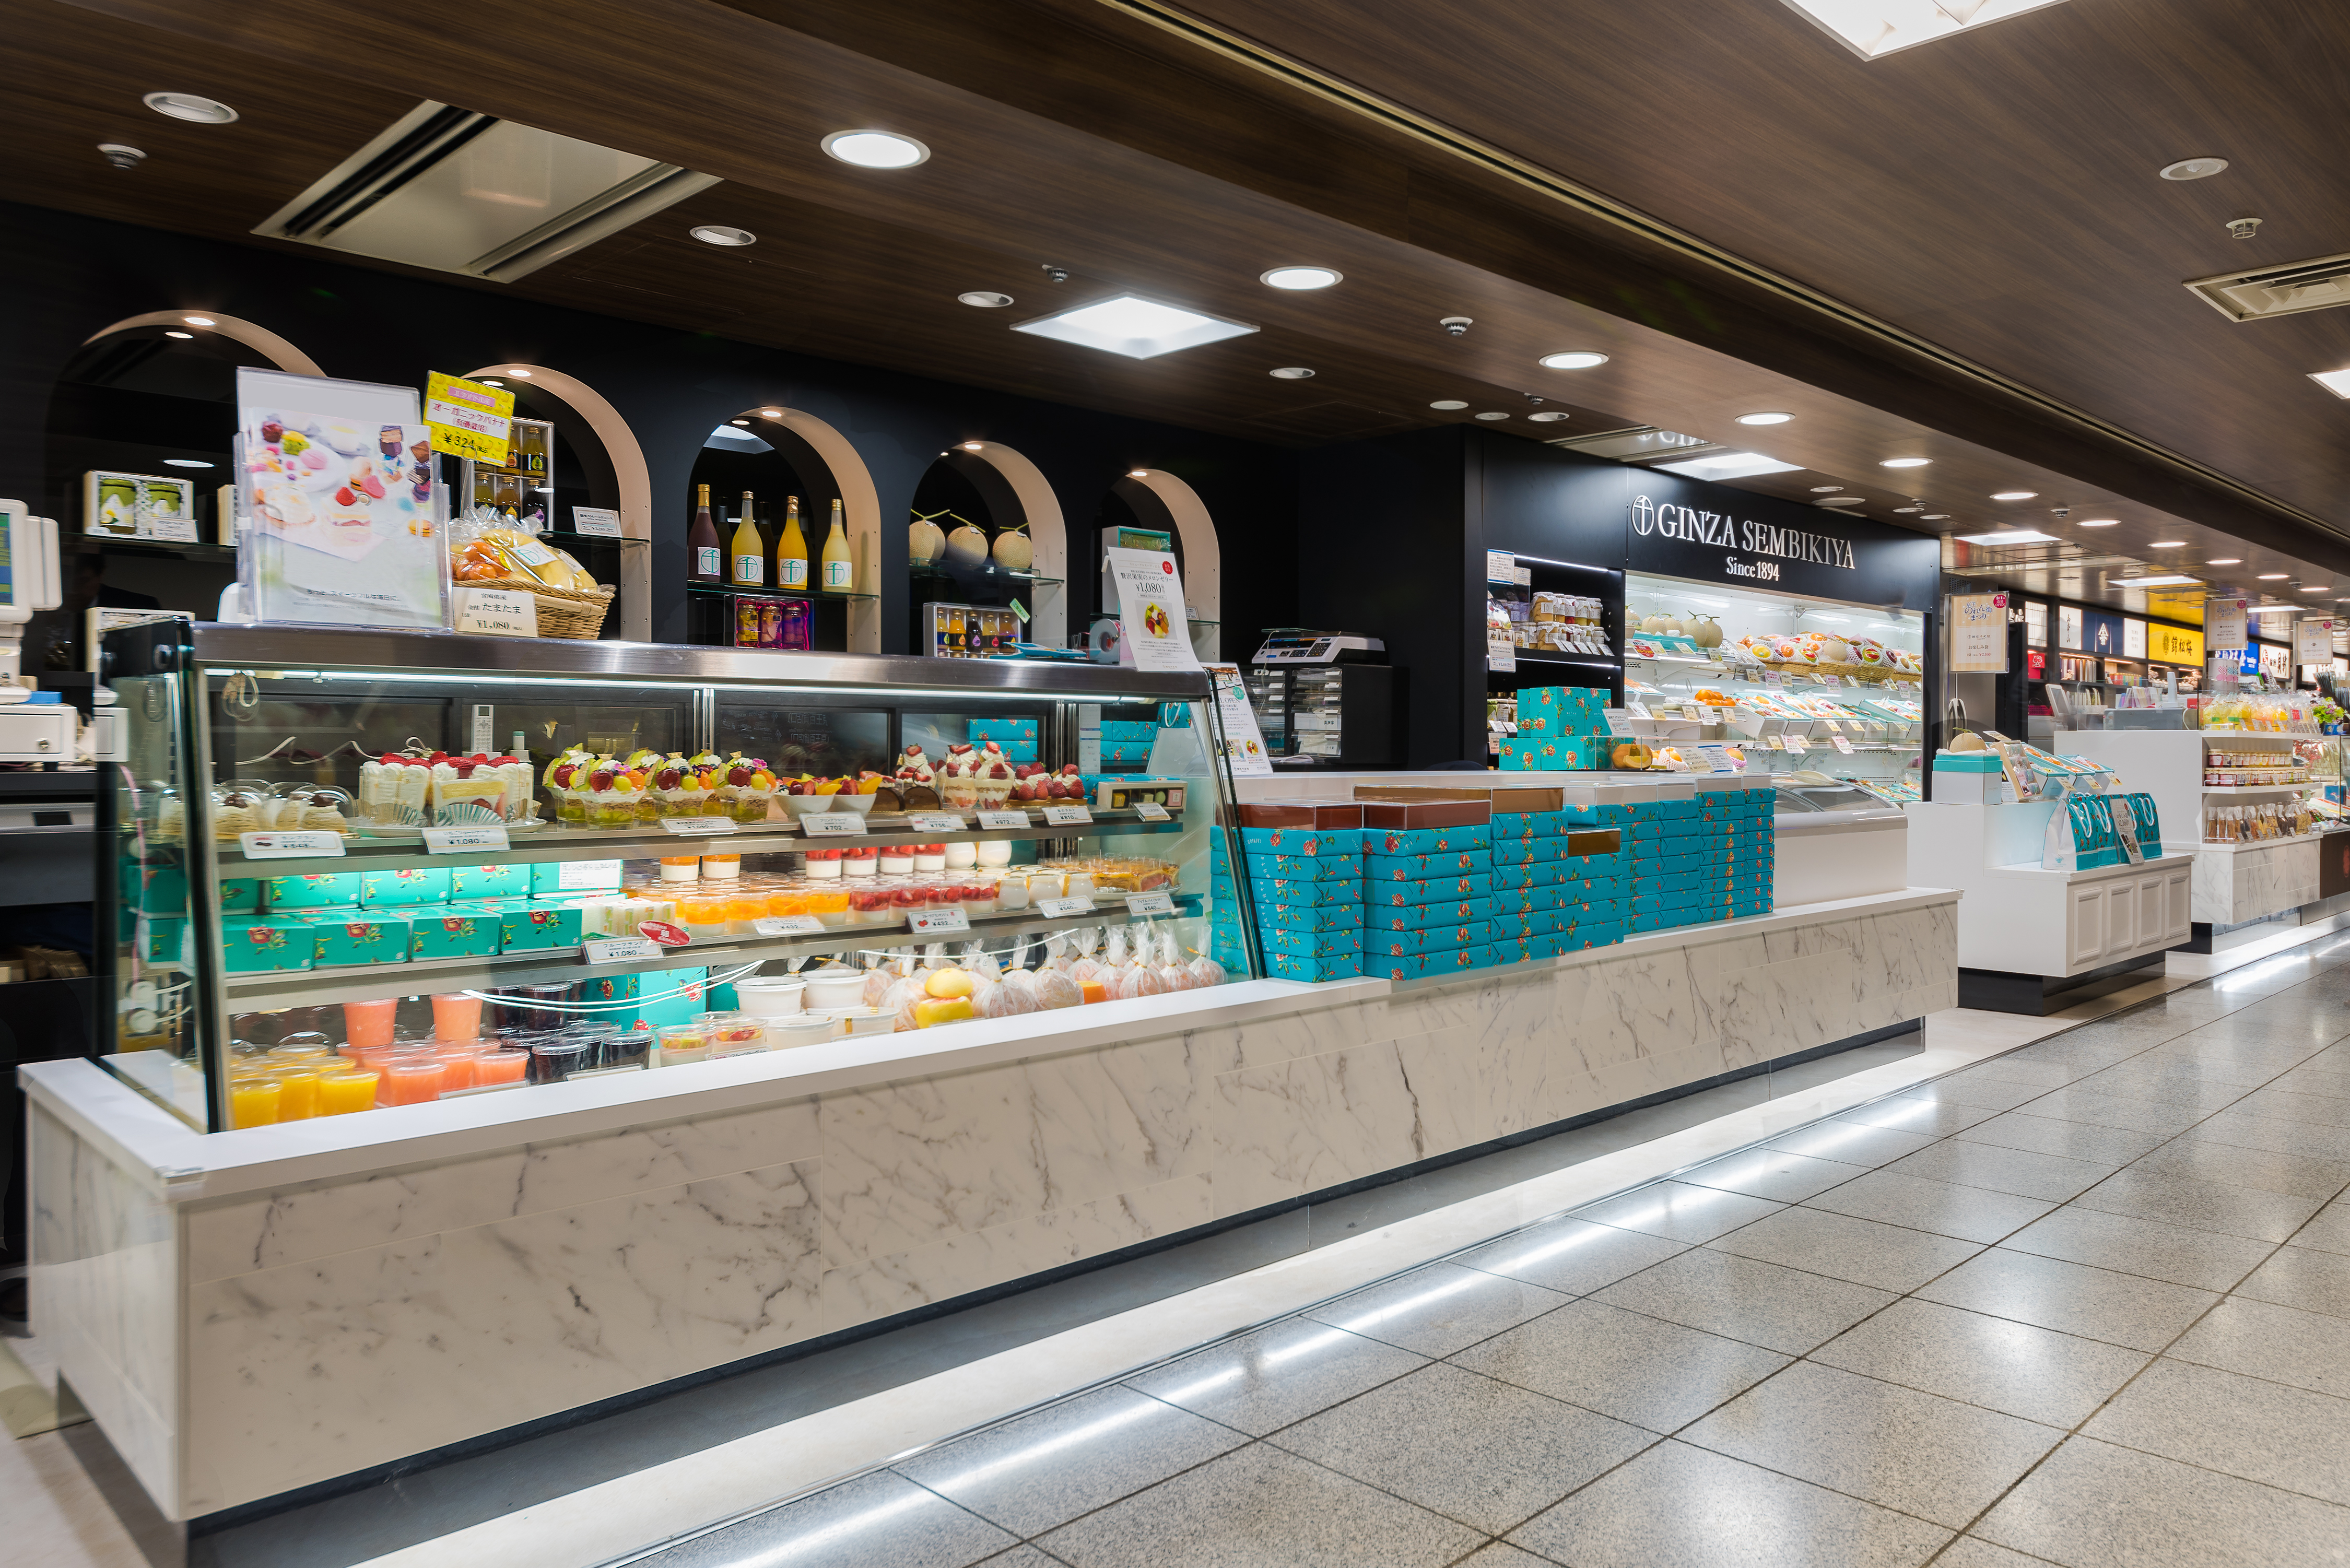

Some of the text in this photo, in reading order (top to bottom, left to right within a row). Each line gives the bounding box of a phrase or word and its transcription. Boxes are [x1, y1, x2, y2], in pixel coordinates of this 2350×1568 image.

[454, 390, 491, 405] エクアドル産
[432, 403, 506, 428] オーガニックバナナ
[1657, 503, 1856, 569] GINZA SEMBIKIYA
[1726, 556, 1780, 582] Since 1894
[1120, 572, 1173, 583] 贅沢果実のメロンゼリー
[1135, 582, 1161, 594] ¥1,080
[481, 603, 522, 614] たまたま
[1964, 605, 1993, 615] のれん街
[1971, 613, 1987, 621] まつり
[476, 619, 510, 630] ¥1,080
[2171, 635, 2192, 656] 錦松梅
